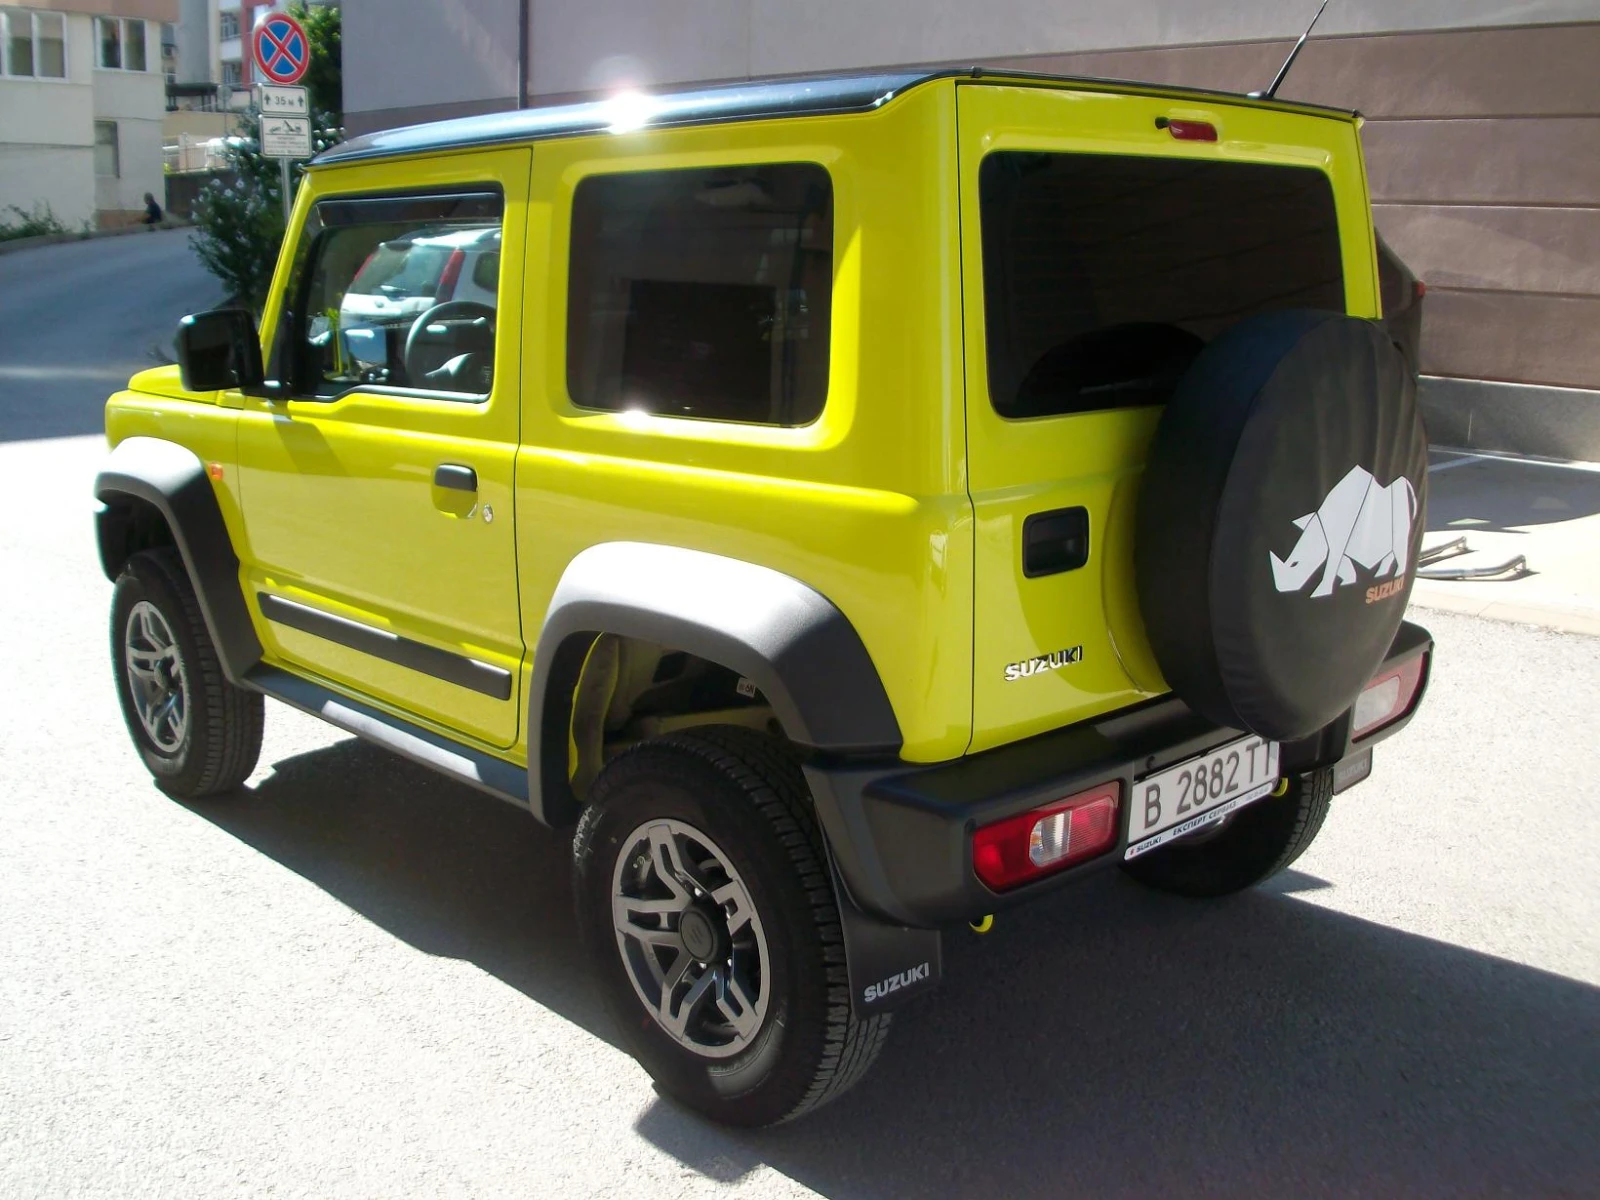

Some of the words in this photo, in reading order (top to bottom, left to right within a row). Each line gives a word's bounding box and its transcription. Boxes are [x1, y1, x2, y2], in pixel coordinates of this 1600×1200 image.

[275, 96, 287, 105] 35
[1365, 575, 1405, 604] SUZUKI
[1004, 645, 1083, 681] SUZUKI
[1144, 783, 1162, 829] B
[1176, 751, 1240, 815] 2882
[1136, 836, 1162, 853] SUZUKI
[1173, 815, 1207, 836] ЕКСПЕРТ
[1208, 800, 1237, 820] СЕРВИЗ
[864, 962, 930, 1002] SUZUKI
